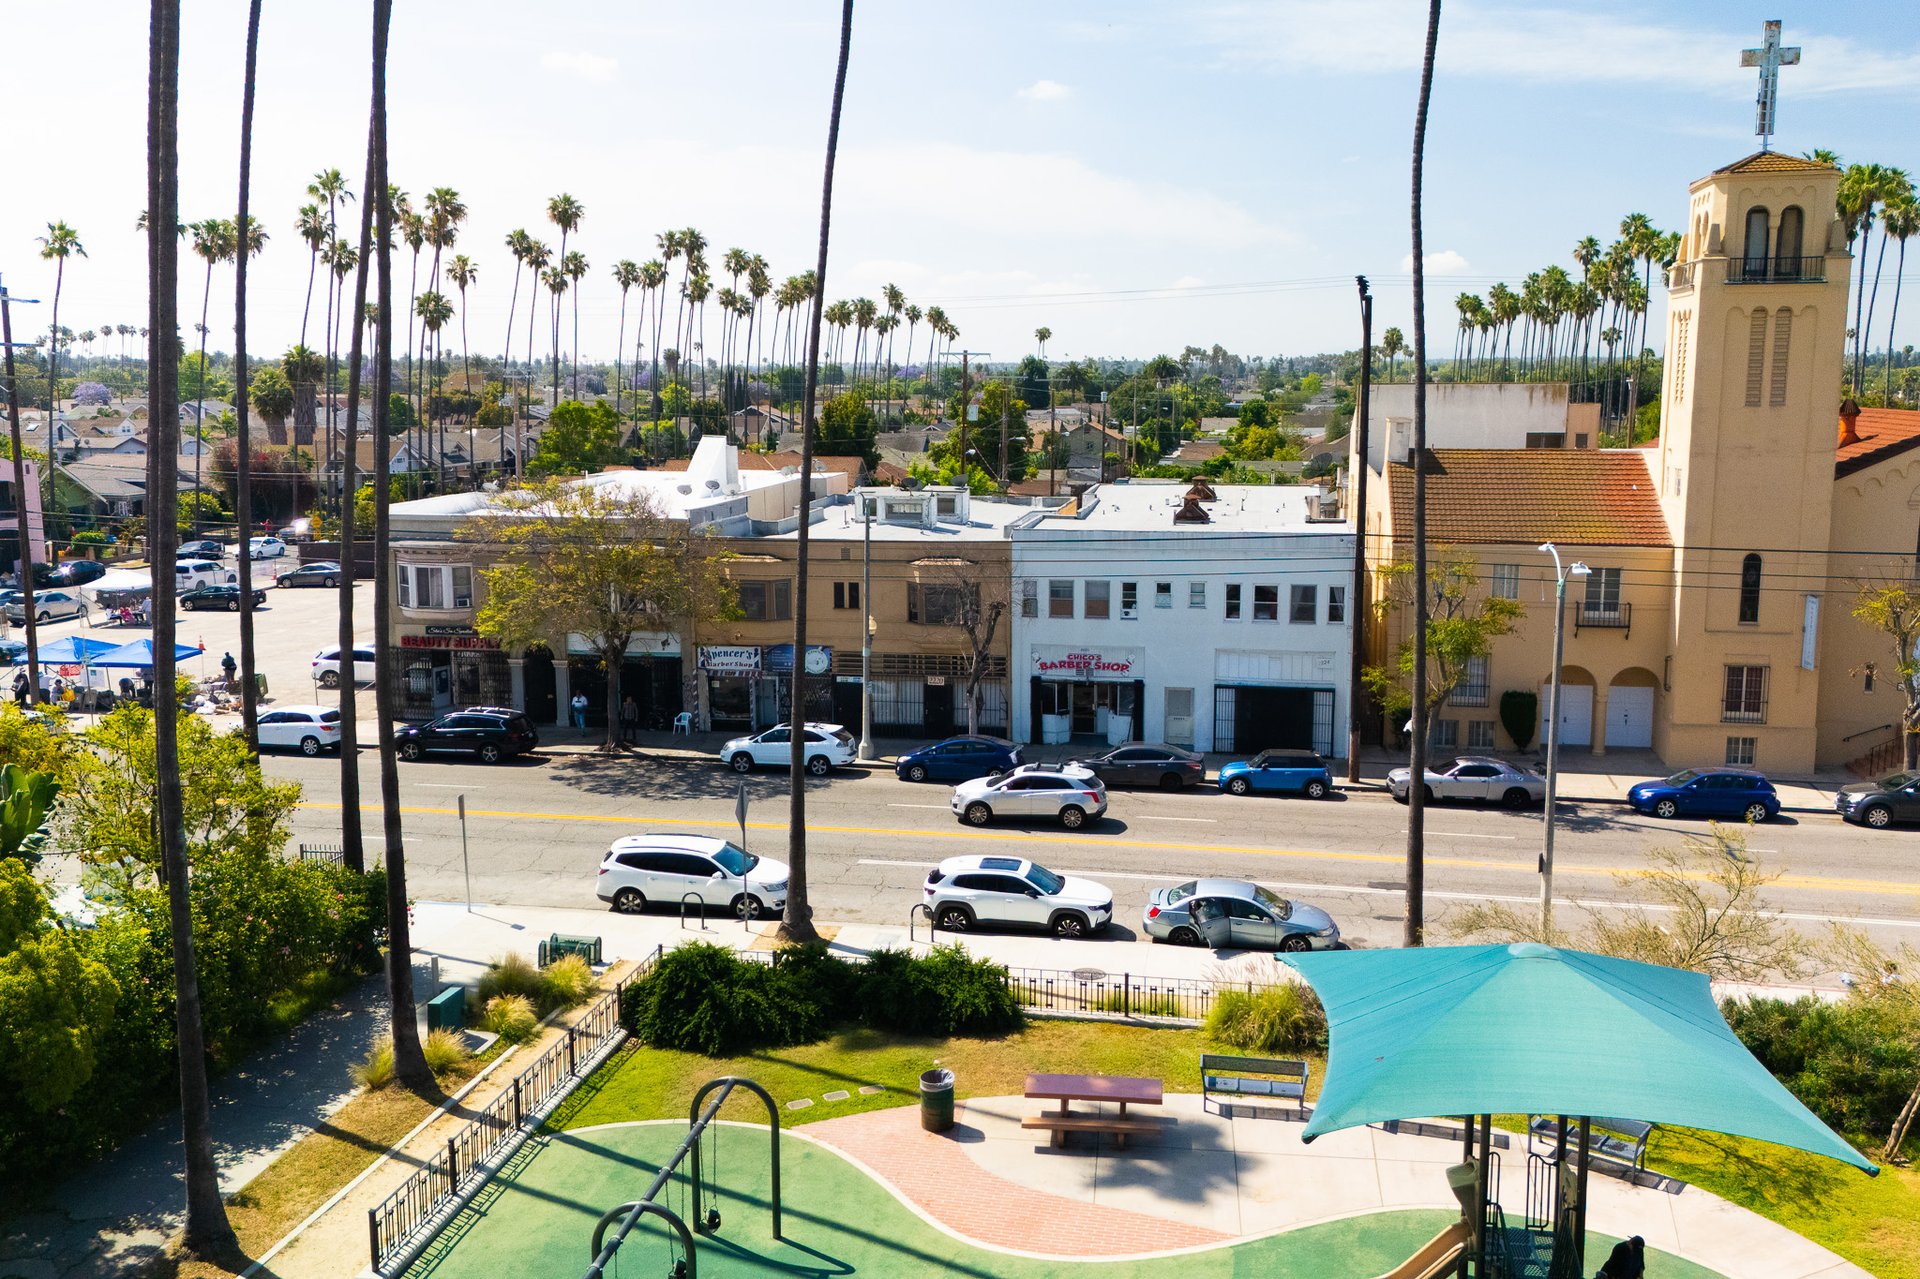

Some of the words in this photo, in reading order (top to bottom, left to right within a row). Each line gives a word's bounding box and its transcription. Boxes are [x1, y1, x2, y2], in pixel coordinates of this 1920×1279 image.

[401, 636, 451, 648] BEAUTY
[1067, 653, 1102, 661] CHICO'S
[1040, 660, 1092, 671] BARBER
[1094, 661, 1130, 672] SHOP
